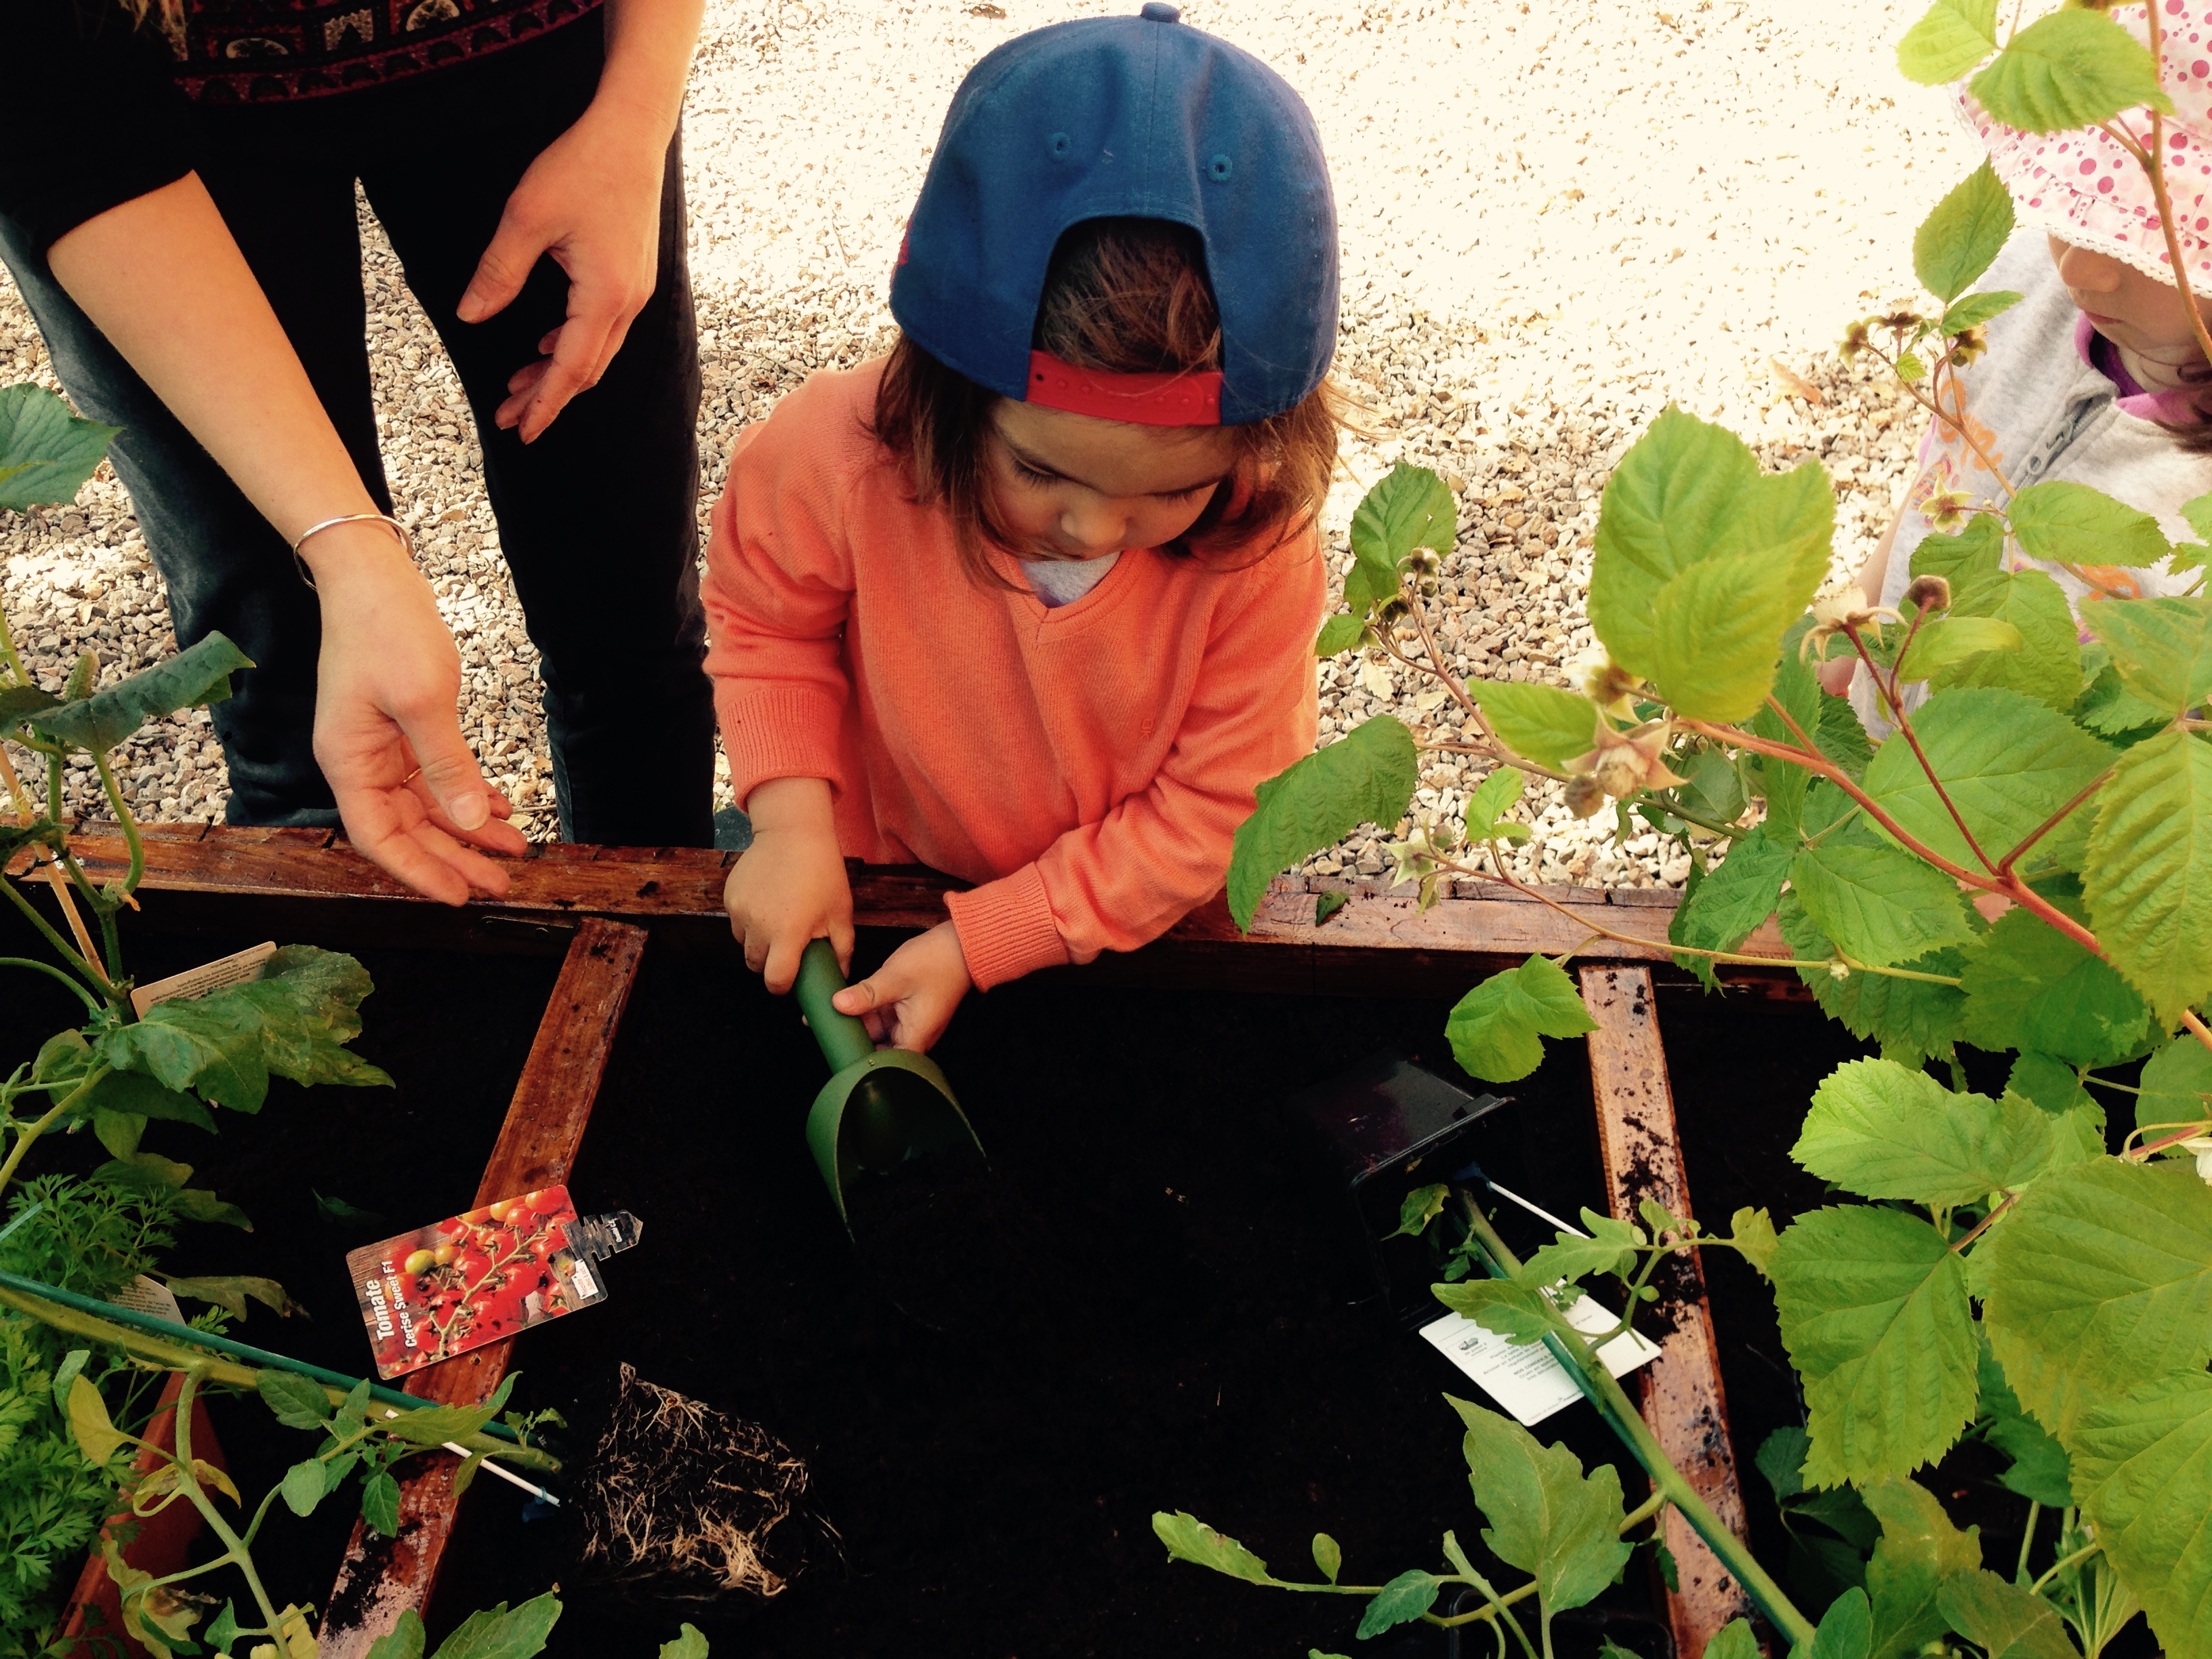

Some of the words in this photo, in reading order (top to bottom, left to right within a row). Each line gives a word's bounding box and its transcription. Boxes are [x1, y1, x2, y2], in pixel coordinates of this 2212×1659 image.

[381, 1261, 396, 1274] F1
[365, 1279, 395, 1340] Tomate
[386, 1275, 407, 1311] Sweet
[399, 1312, 417, 1347] Cerise
